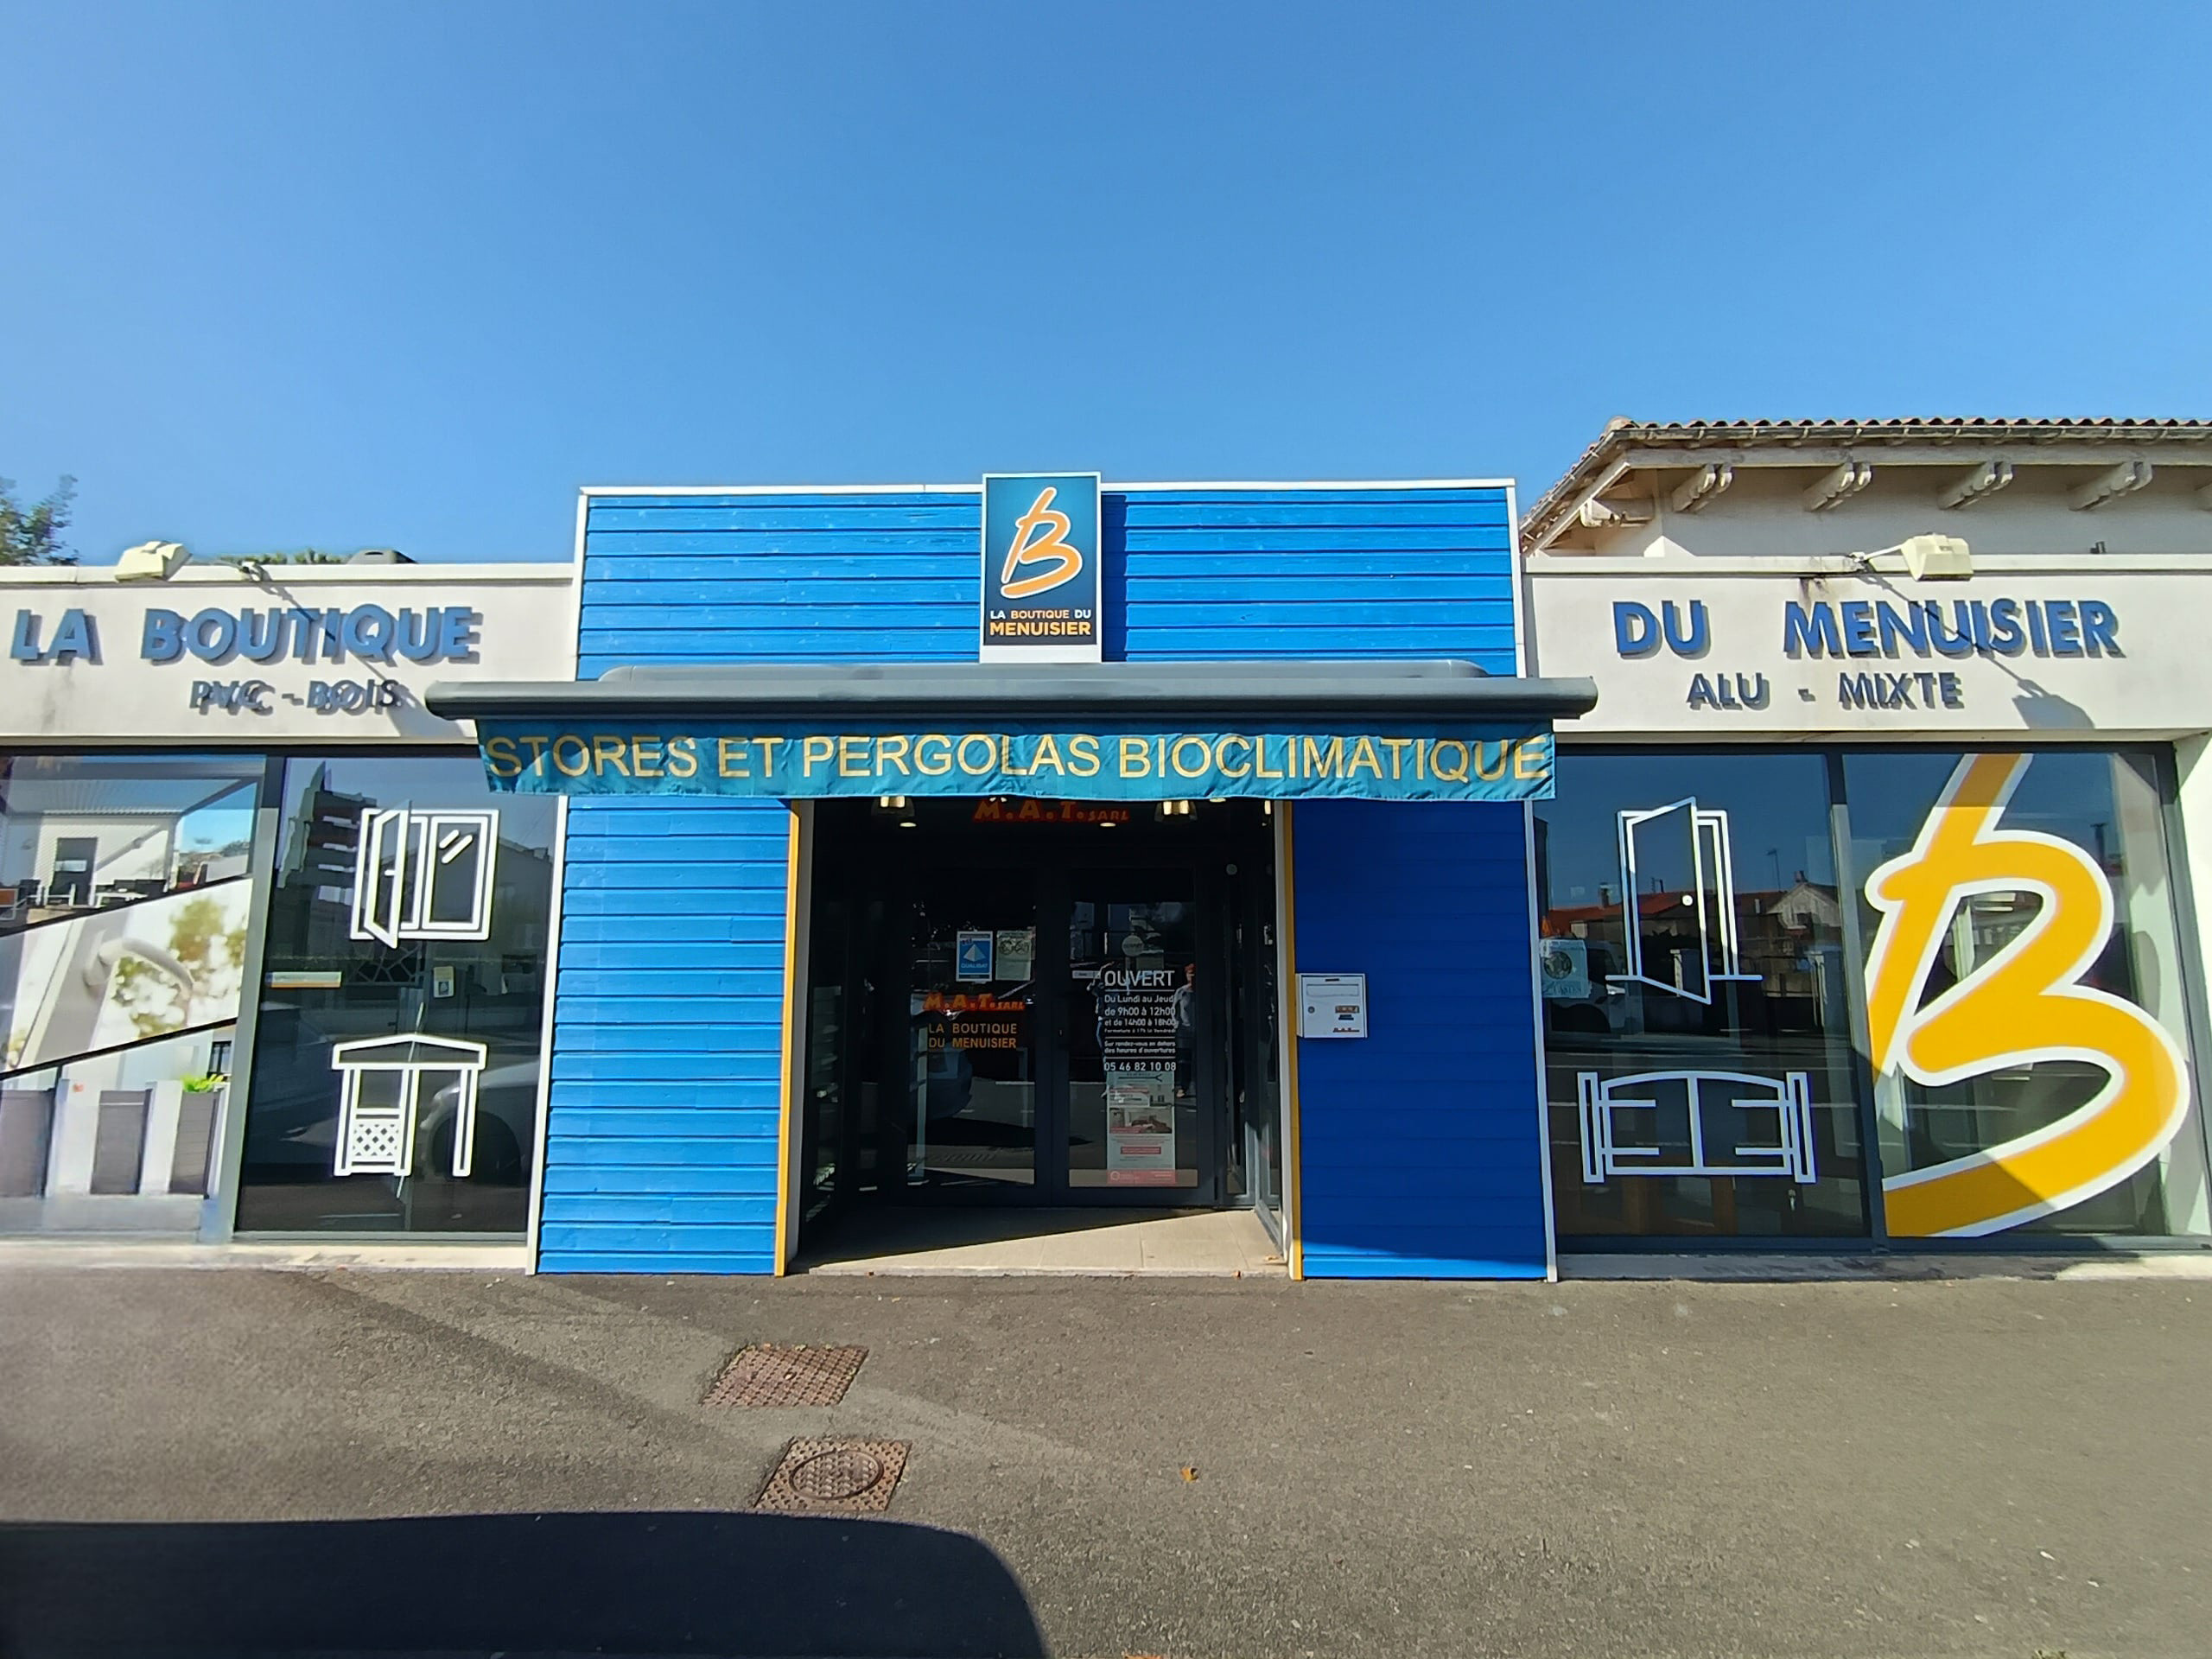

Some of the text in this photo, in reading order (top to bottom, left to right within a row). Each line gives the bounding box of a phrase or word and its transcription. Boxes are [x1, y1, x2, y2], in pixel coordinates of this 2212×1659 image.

[990, 609, 1091, 620] LA BOUTIQUE DU
[10, 603, 474, 664] LA BOUTIQUE
[989, 622, 1091, 636] MENUISIER
[1612, 599, 2122, 656] DU MENUISIER
[189, 679, 268, 710] PVC
[307, 679, 401, 709] BOIS
[1686, 672, 1764, 707] ALU
[1839, 672, 1958, 707] MIXTE
[485, 734, 1549, 783] STORES ET PERGOLAS BIOCLIMATIQUE
[1104, 970, 1175, 987] OUVERT
[1104, 995, 1116, 1003] Du
[1117, 995, 1141, 1003] Lundi
[1104, 1006, 1176, 1016] de 9h00 à 12h00
[929, 1023, 1018, 1034] LA BOUTIQUE
[1125, 1018, 1146, 1027] 14h00
[929, 1038, 1017, 1048] DU MENUISIER
[1104, 1062, 1176, 1071] 05 46 82 10 08
